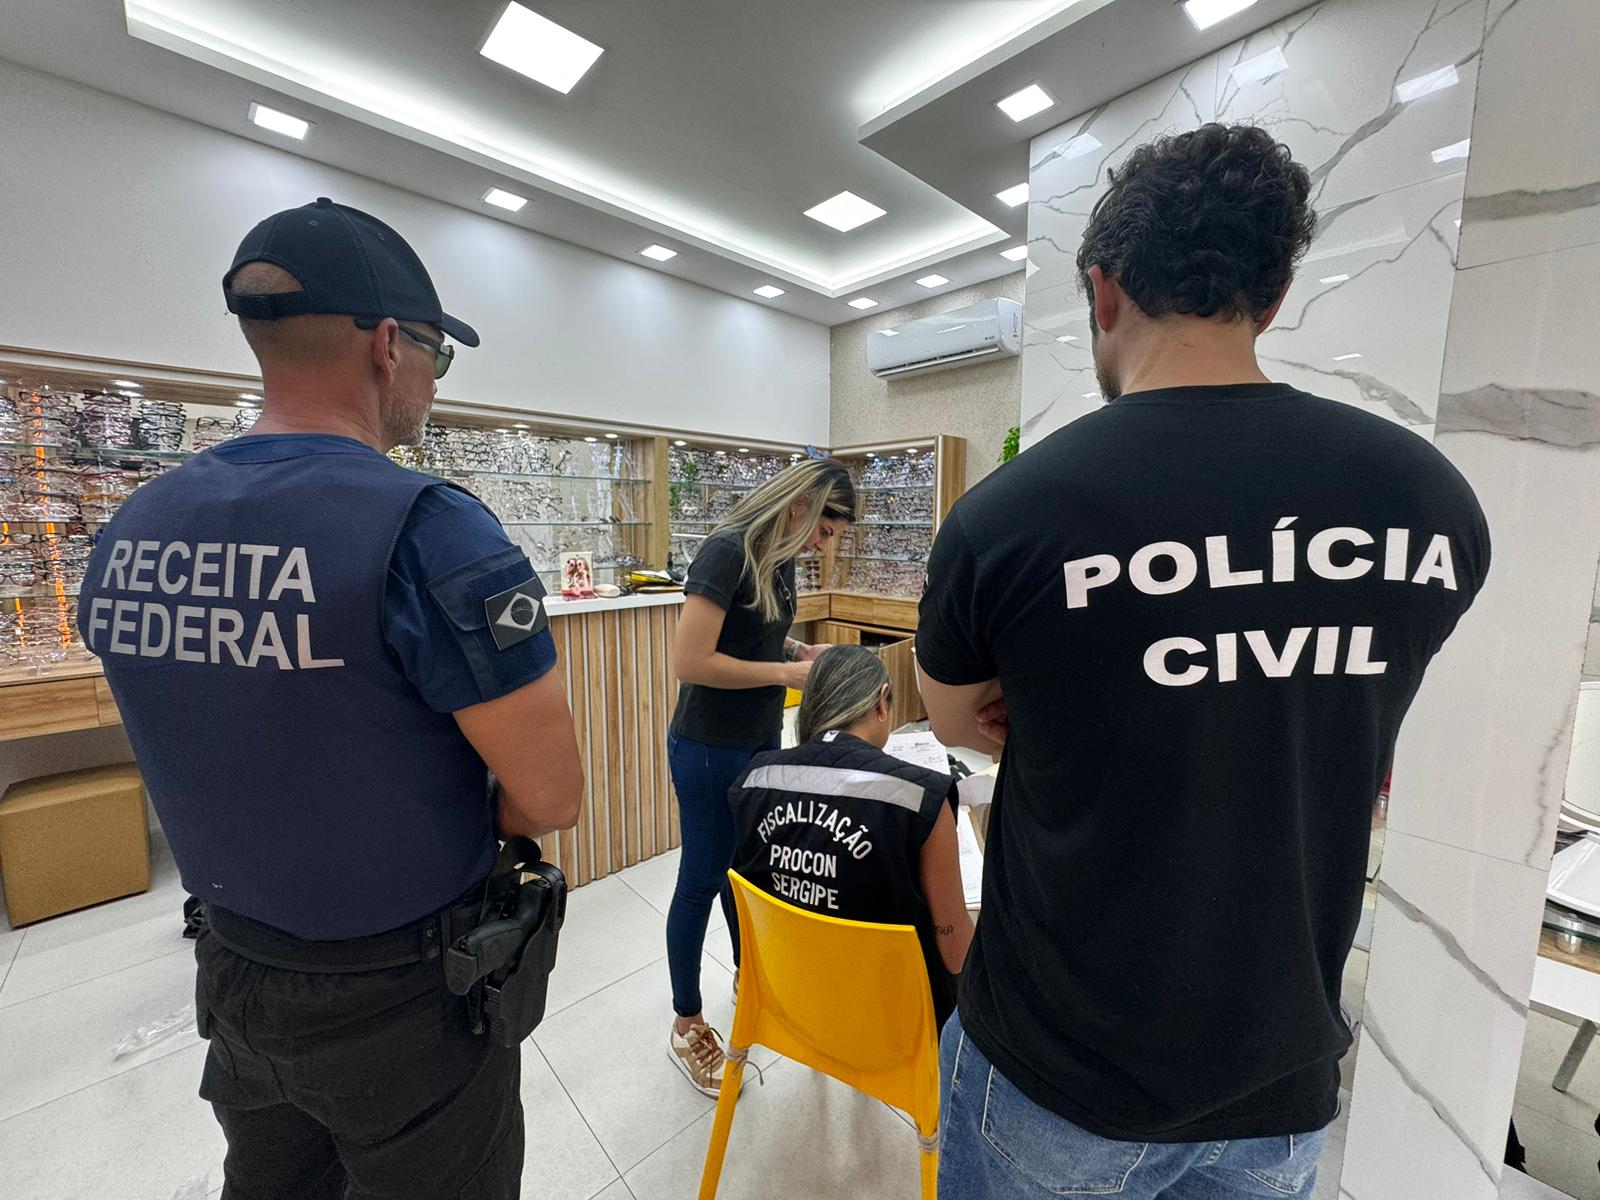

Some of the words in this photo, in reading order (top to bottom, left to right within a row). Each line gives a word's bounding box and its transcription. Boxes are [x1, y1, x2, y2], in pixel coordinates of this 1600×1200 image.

[101, 539, 317, 604] RECEITA
[1063, 516, 1459, 610] POLÍCIA
[88, 597, 346, 671] FEDERAL
[1142, 626, 1388, 687] CIVIL
[756, 800, 873, 861] FISCALIZAÇÃO
[769, 844, 837, 878] PROCON
[771, 872, 840, 911] SERGIPE
